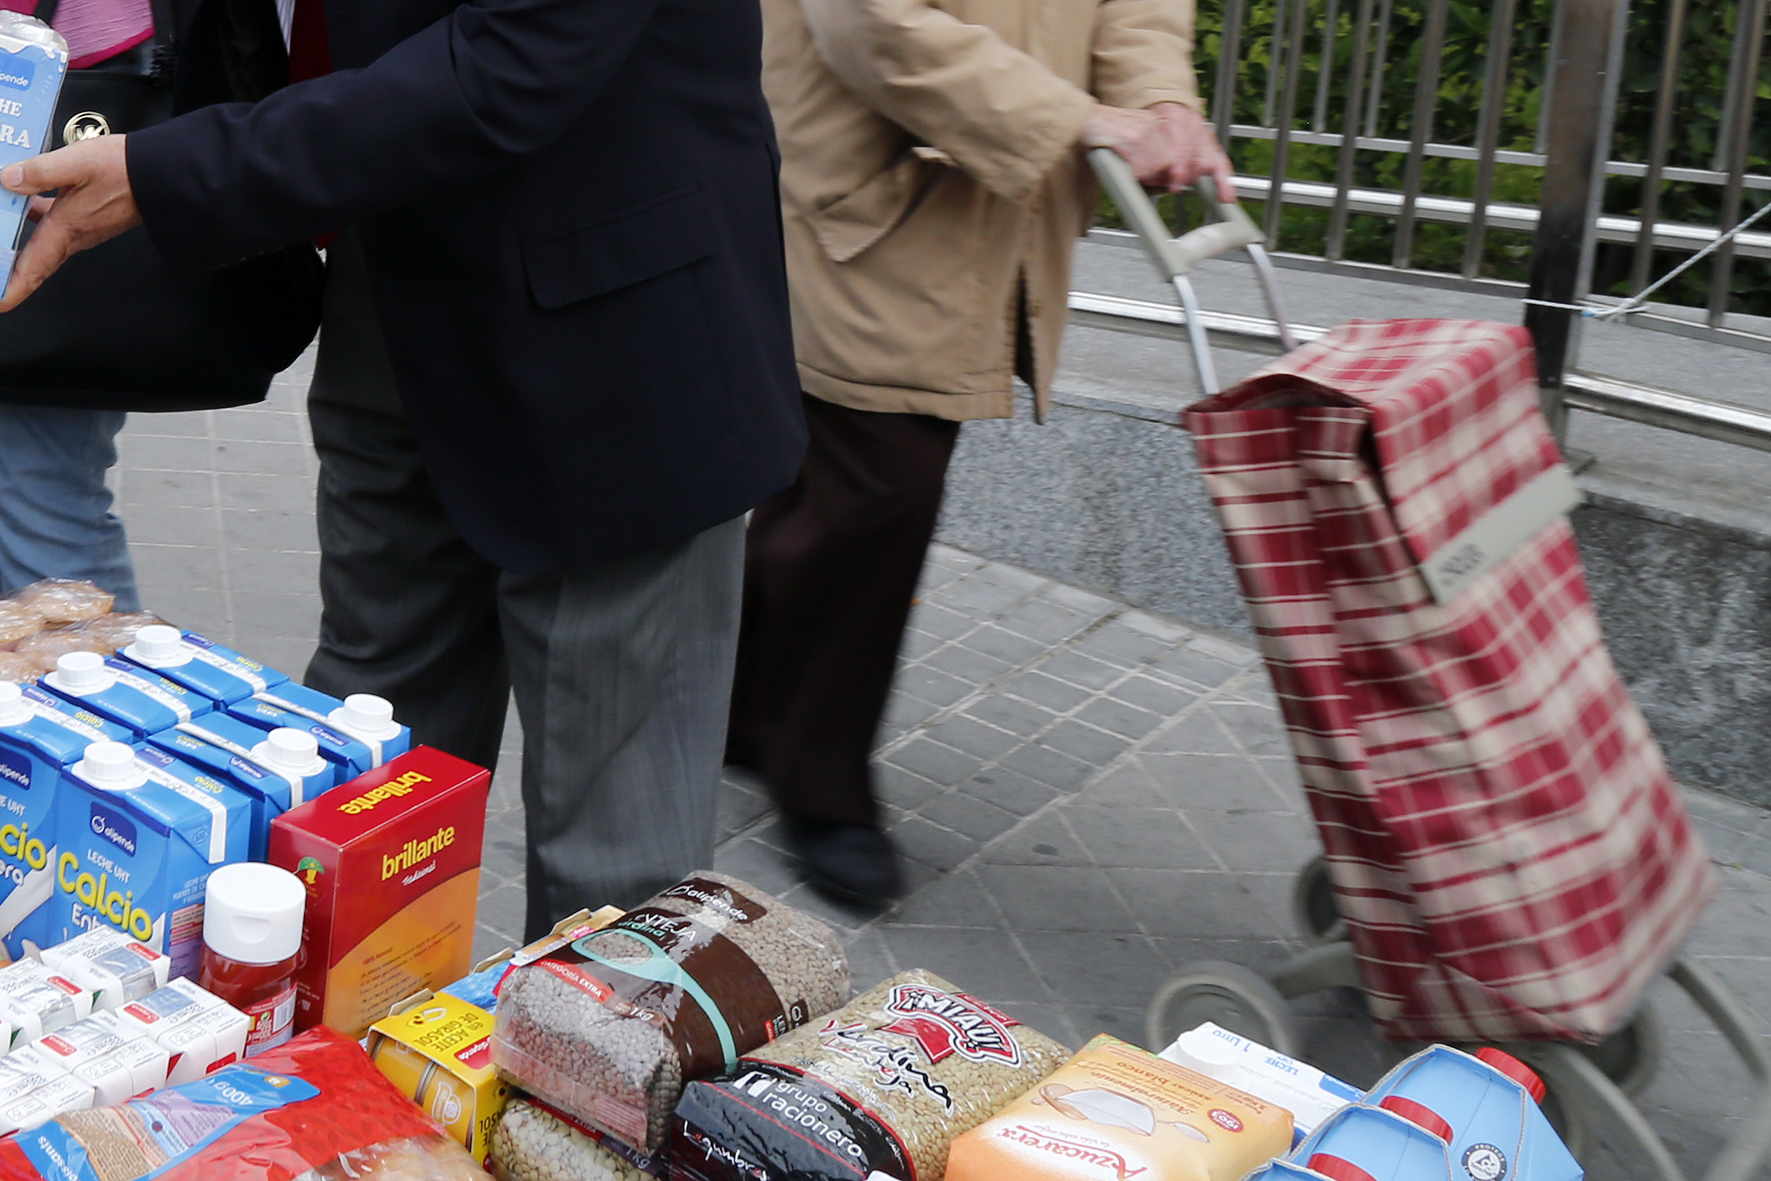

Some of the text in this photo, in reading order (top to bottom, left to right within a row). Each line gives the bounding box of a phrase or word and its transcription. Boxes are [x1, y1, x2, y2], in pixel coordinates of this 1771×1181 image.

[7, 797, 26, 817] UHT
[336, 770, 433, 815] brillante
[103, 825, 136, 855] alipende
[381, 825, 456, 882] brillante
[86, 848, 131, 885] LECHE UHT
[58, 851, 153, 941] Calcio
[686, 886, 749, 922] alipende
[578, 976, 603, 998] EXTRA
[412, 1011, 480, 1047] DE GIRASOL
[432, 1029, 470, 1052] ACEITE
[1116, 1061, 1169, 1085] blanco
[1263, 1055, 1300, 1076] LECHE
[213, 1079, 254, 1107] 400g
[775, 1076, 829, 1115] grupo
[761, 1091, 864, 1159] racionero
